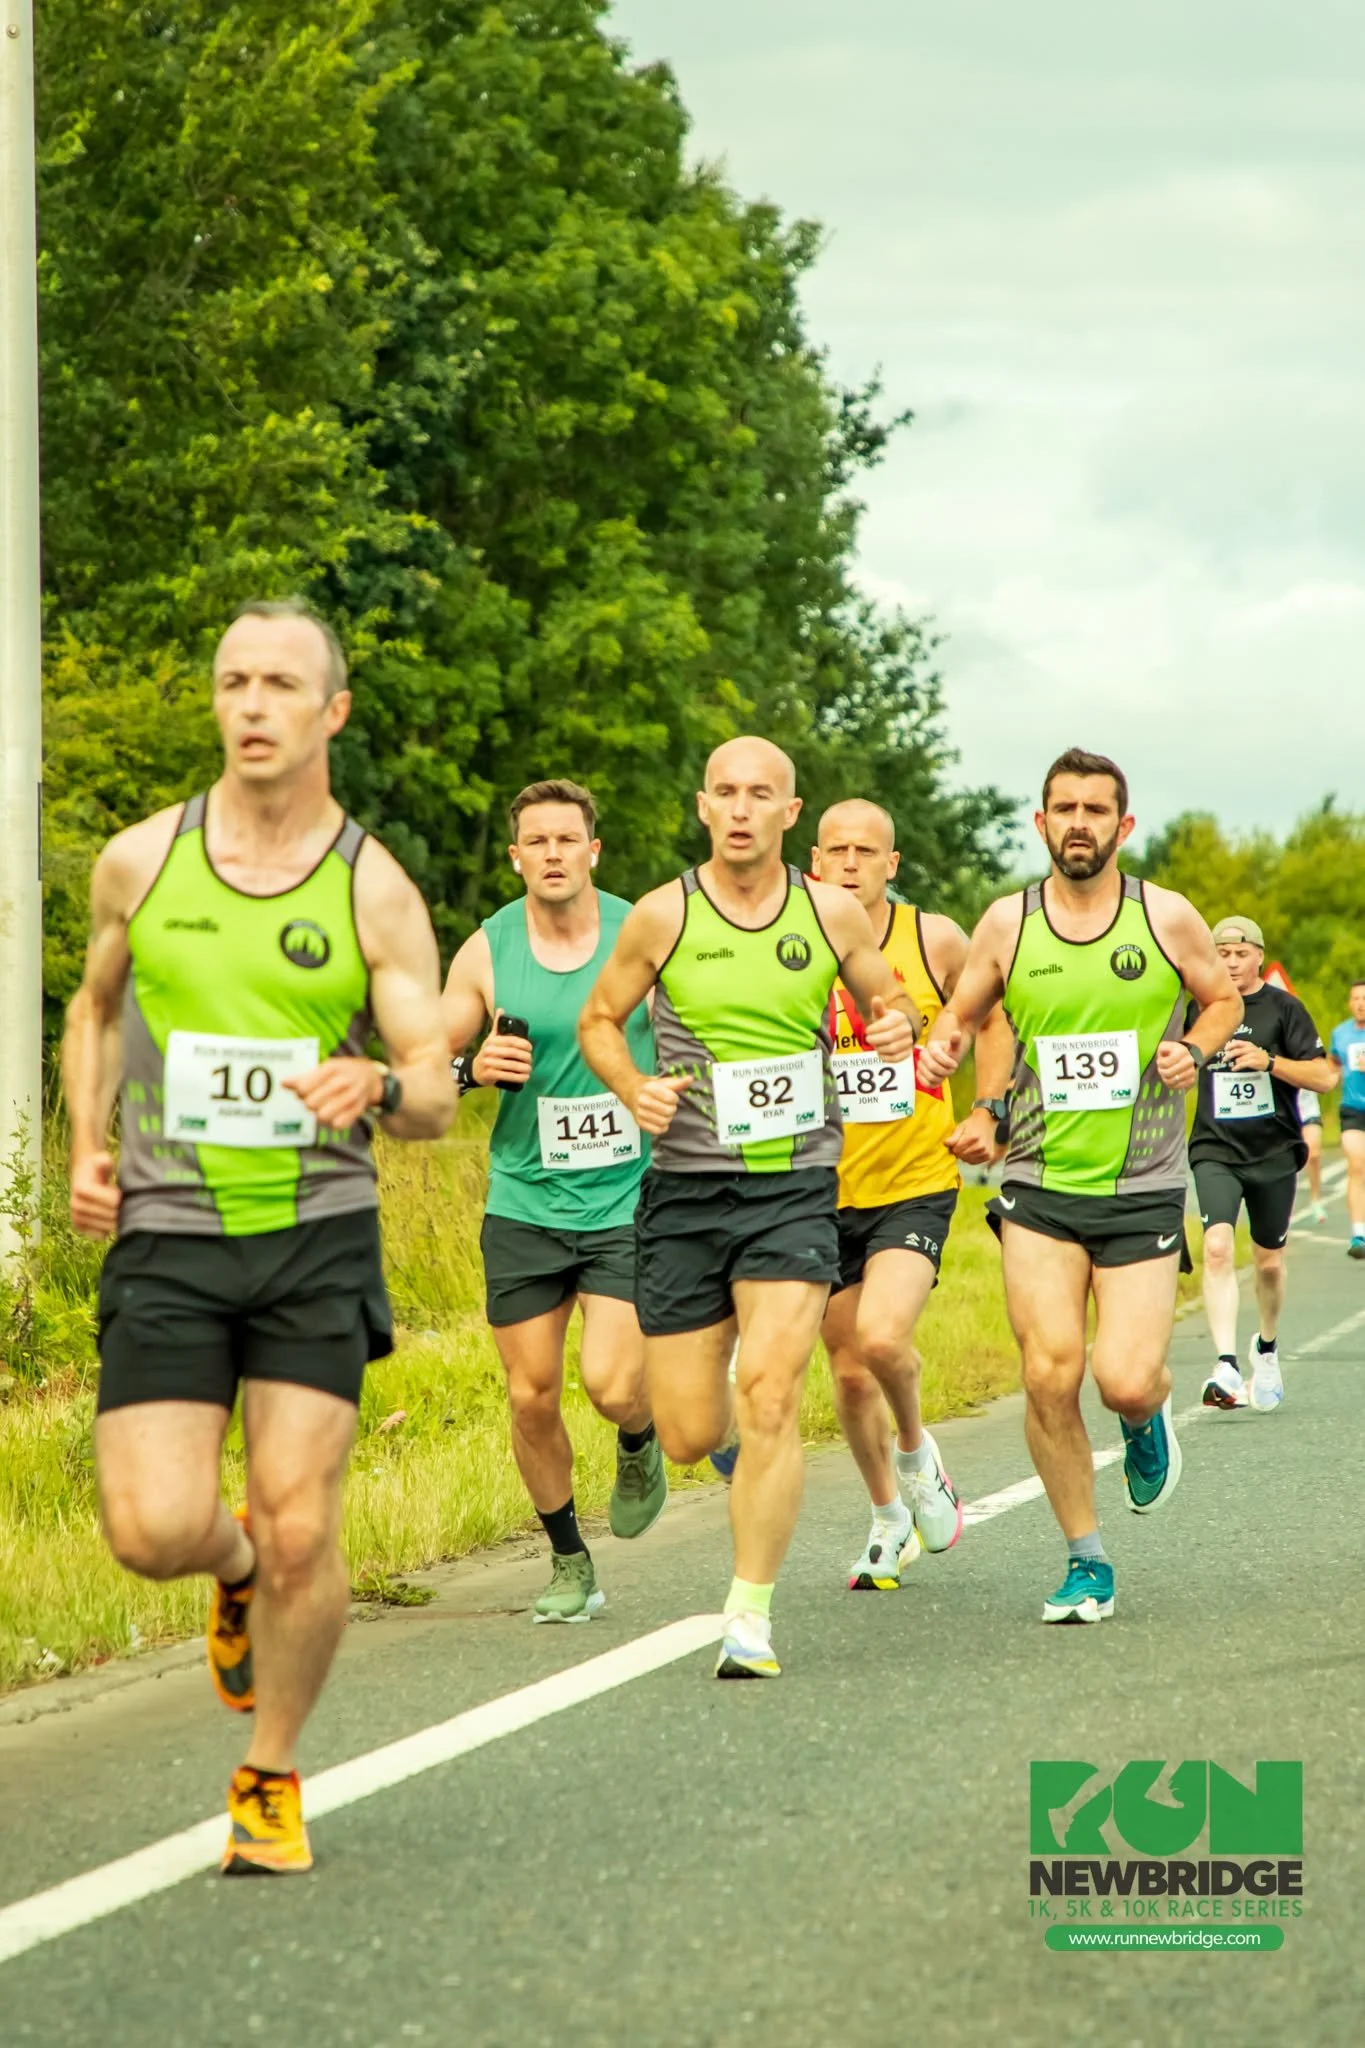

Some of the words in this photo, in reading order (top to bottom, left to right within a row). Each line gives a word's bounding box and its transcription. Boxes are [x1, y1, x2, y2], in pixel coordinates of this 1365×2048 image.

[696, 947, 735, 961] oneills
[1028, 963, 1063, 978] oneills
[1052, 1042, 1067, 1050] RUN
[1069, 1038, 1119, 1049] NEWBRIDGE
[732, 1067, 751, 1077] RUN
[753, 1060, 804, 1076] NEWBRIDGE
[832, 1058, 848, 1067] RUN
[850, 1056, 883, 1066] NEWBRI
[1055, 1051, 1119, 1080] 139
[210, 1064, 273, 1103] 10
[836, 1067, 898, 1095] 182
[1077, 1082, 1099, 1090] RYAN
[749, 1076, 794, 1108] 82
[1230, 1082, 1256, 1099] 49
[859, 1096, 879, 1105] JOHN
[553, 1104, 569, 1112] RUN
[763, 1108, 785, 1118] RYAN
[556, 1110, 623, 1140] 141
[571, 1140, 610, 1150] SEAGHAN
